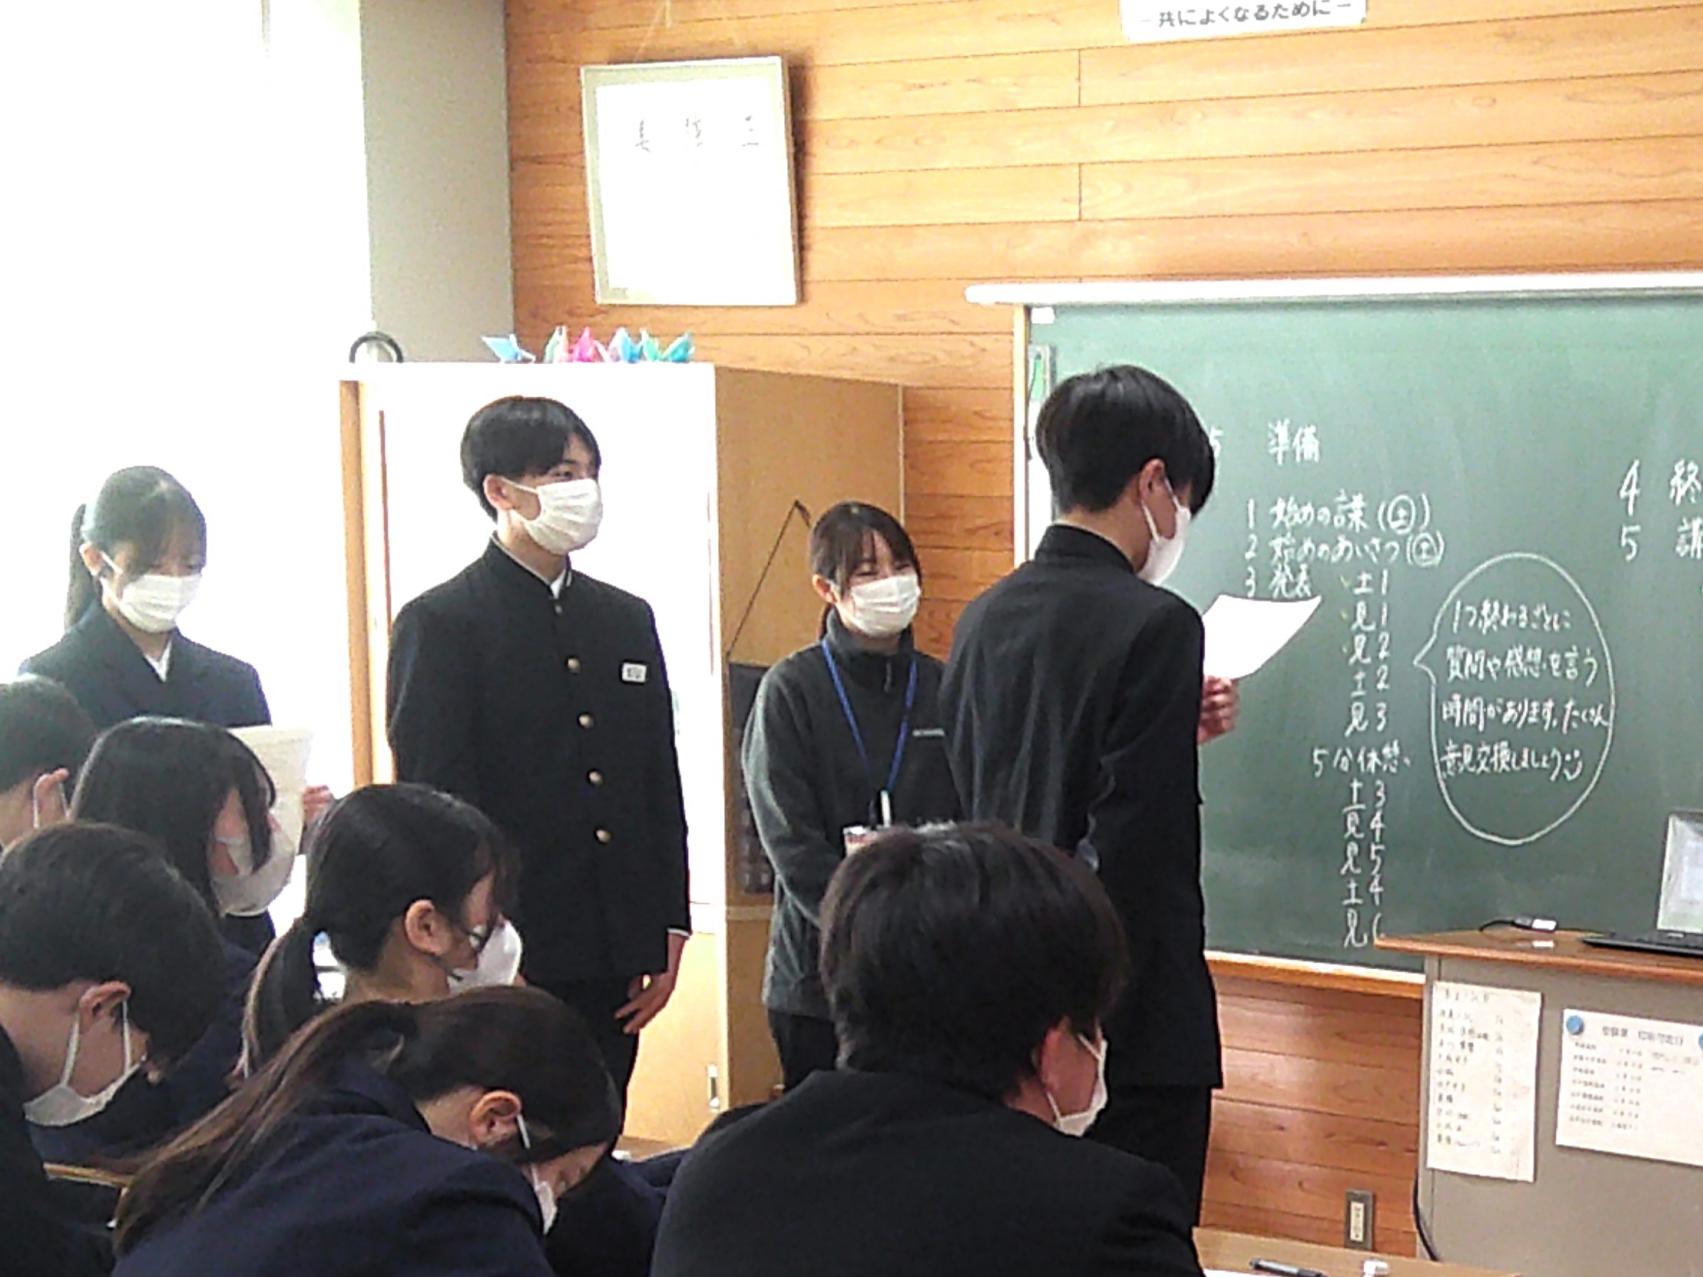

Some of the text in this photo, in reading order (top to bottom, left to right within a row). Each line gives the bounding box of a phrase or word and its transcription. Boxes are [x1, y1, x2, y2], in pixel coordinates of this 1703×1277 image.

[1268, 418, 1320, 465] 準備
[1619, 459, 1640, 516] 4
[1245, 533, 1257, 560] 2
[1620, 524, 1641, 562] 5
[1268, 563, 1312, 599] 発表
[1378, 631, 1390, 660] 2
[1376, 664, 1390, 691] 2
[1446, 643, 1598, 687] 質問や感想を言う
[1376, 702, 1387, 733] 3
[1375, 780, 1386, 808] 3
[1370, 809, 1385, 843] 4
[1370, 842, 1385, 876] 5
[1369, 873, 1384, 906] 4
